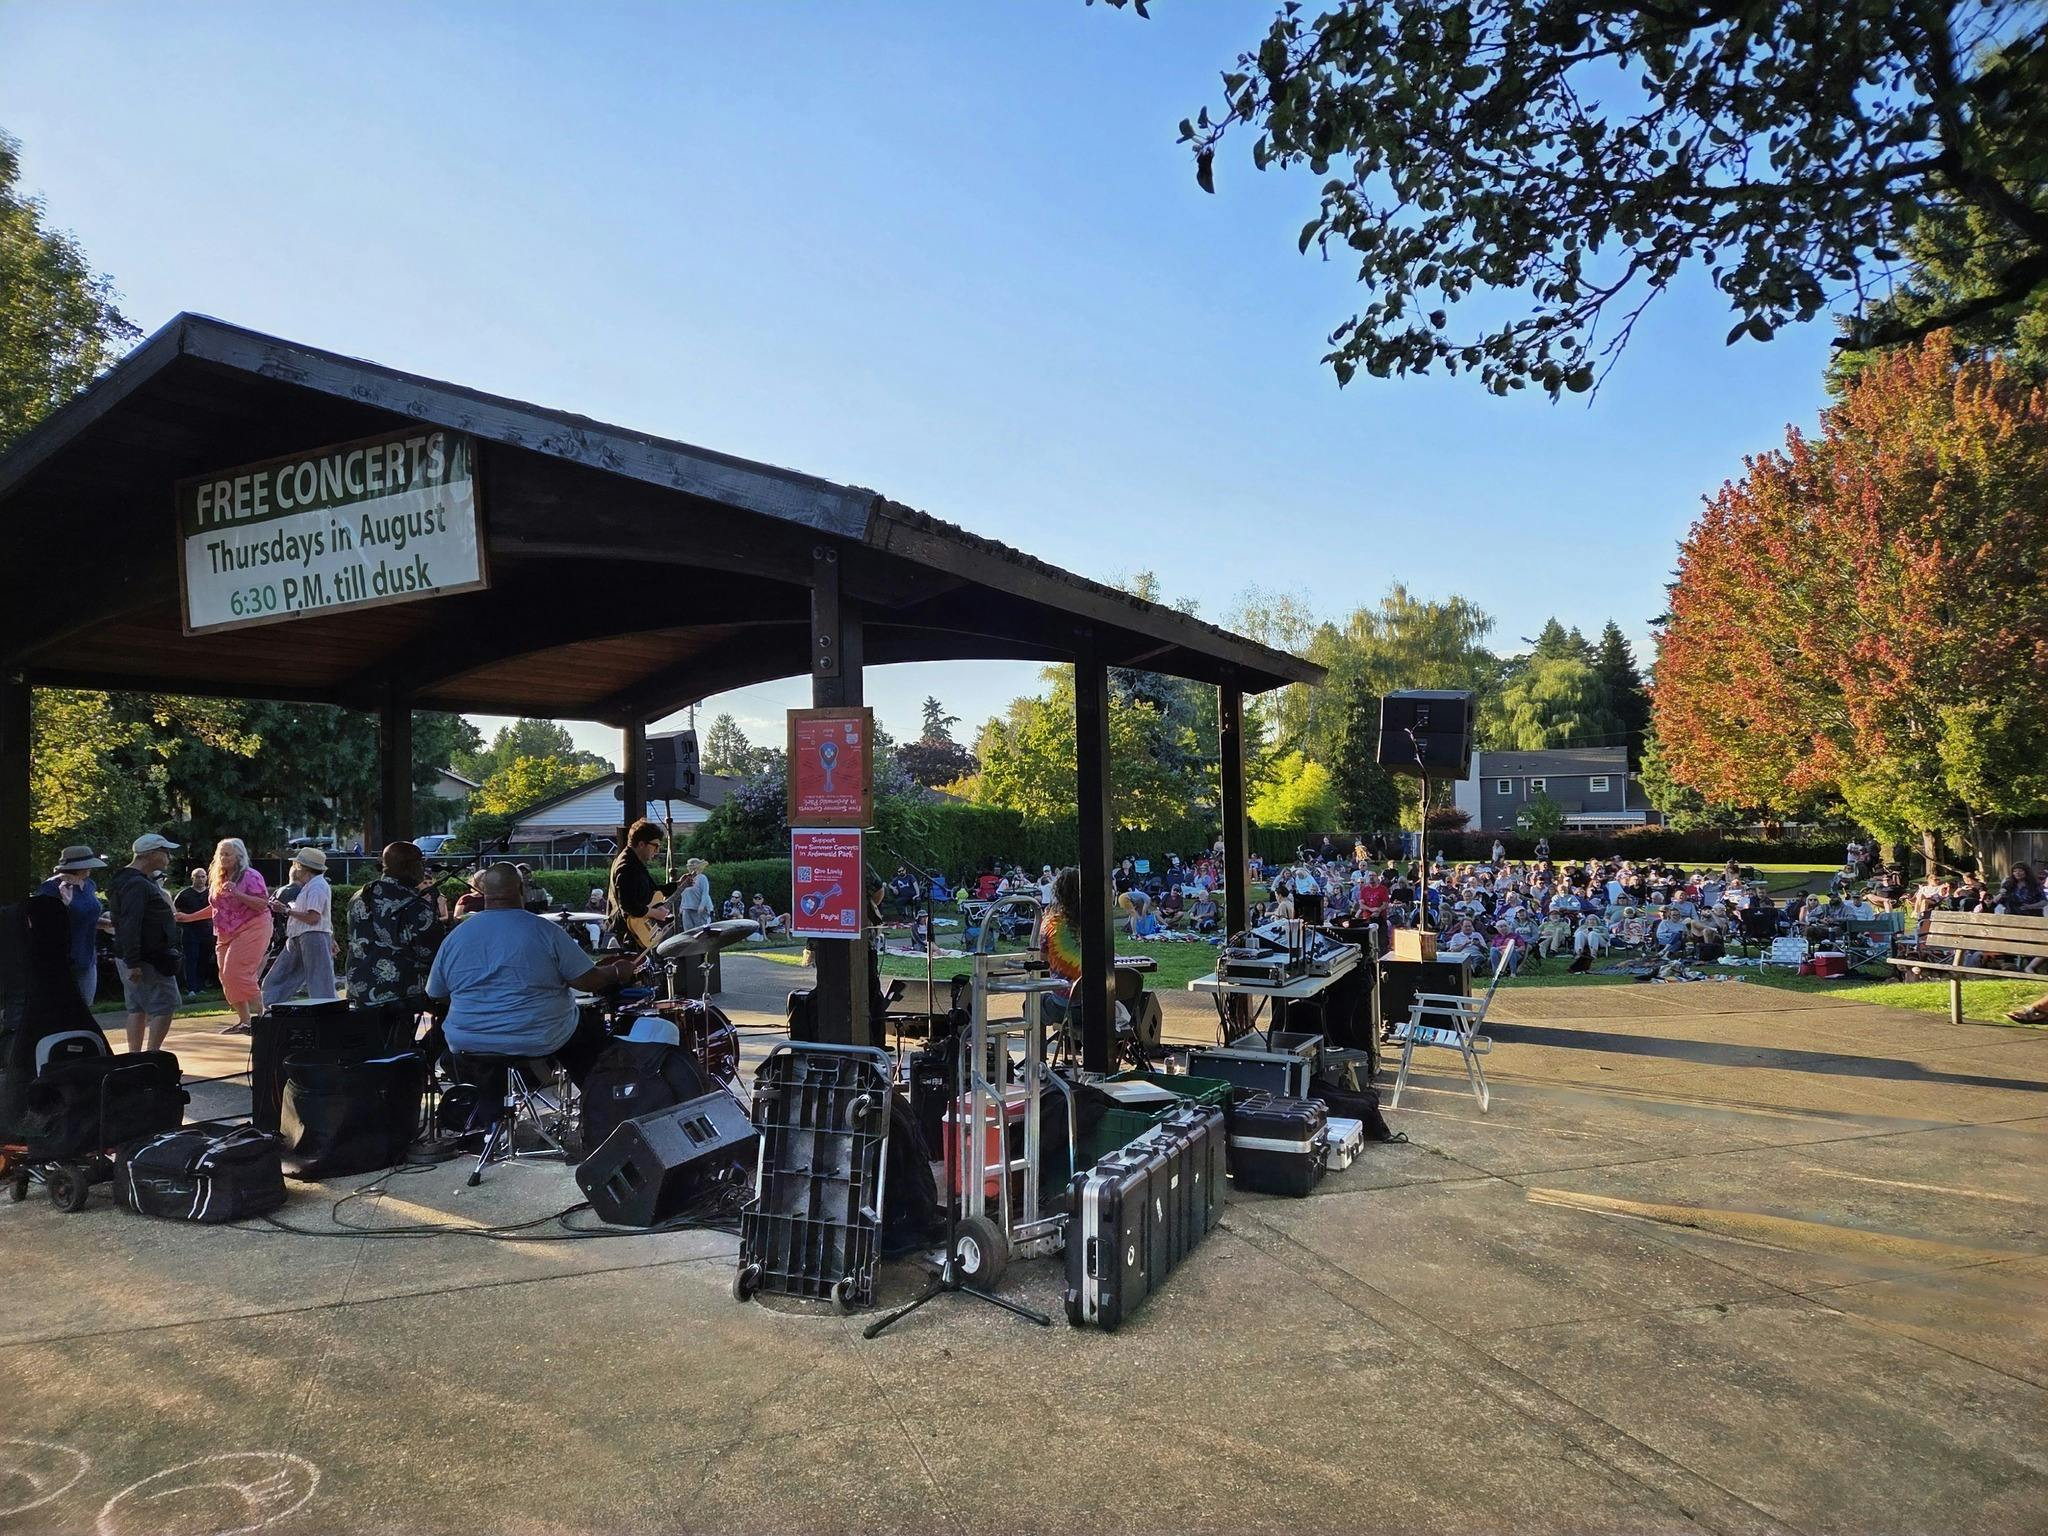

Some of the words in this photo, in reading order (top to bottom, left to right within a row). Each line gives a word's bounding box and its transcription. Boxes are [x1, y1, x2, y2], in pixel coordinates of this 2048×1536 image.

[197, 471, 269, 525] FREE
[276, 432, 445, 508] CONCERTS
[207, 528, 324, 574] Thursdays
[331, 516, 352, 552] in
[360, 502, 446, 550] August
[230, 584, 277, 616] 6:30
[283, 573, 331, 610] P.M.
[334, 563, 367, 602] till
[372, 553, 433, 596] dusk
